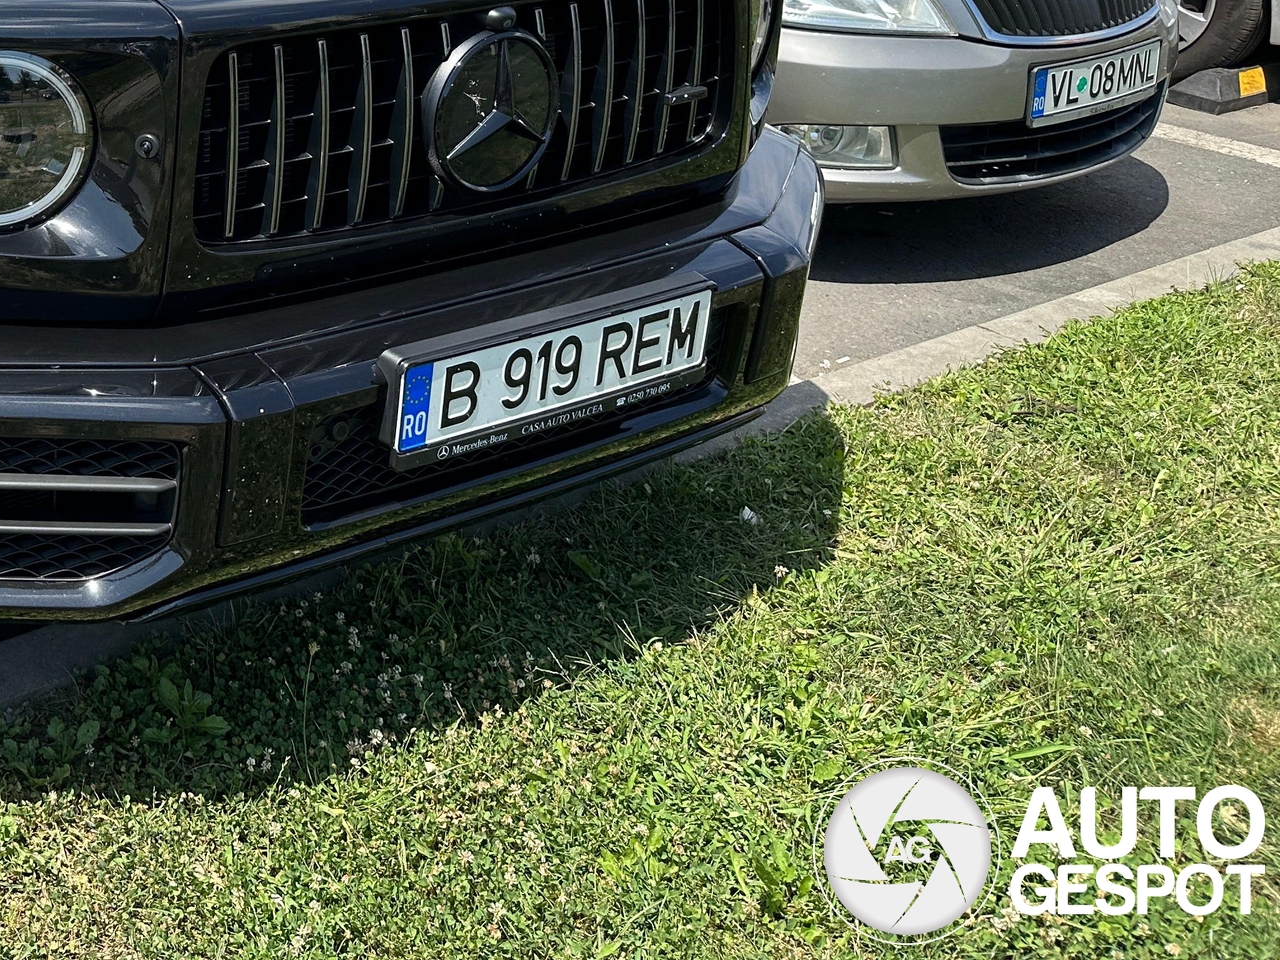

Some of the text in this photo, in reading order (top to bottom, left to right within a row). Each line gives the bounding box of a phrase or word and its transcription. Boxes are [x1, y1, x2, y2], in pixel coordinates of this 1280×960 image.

[1051, 49, 1154, 108] VL 08 MNL
[1033, 96, 1045, 112] RO
[440, 300, 701, 429] B 919 REM
[627, 390, 644, 403] 0250
[644, 387, 658, 399] 730
[401, 411, 427, 440] RO
[521, 403, 604, 435] CASA AUTO VALCEA
[451, 433, 509, 455] Mercedes-Benz
